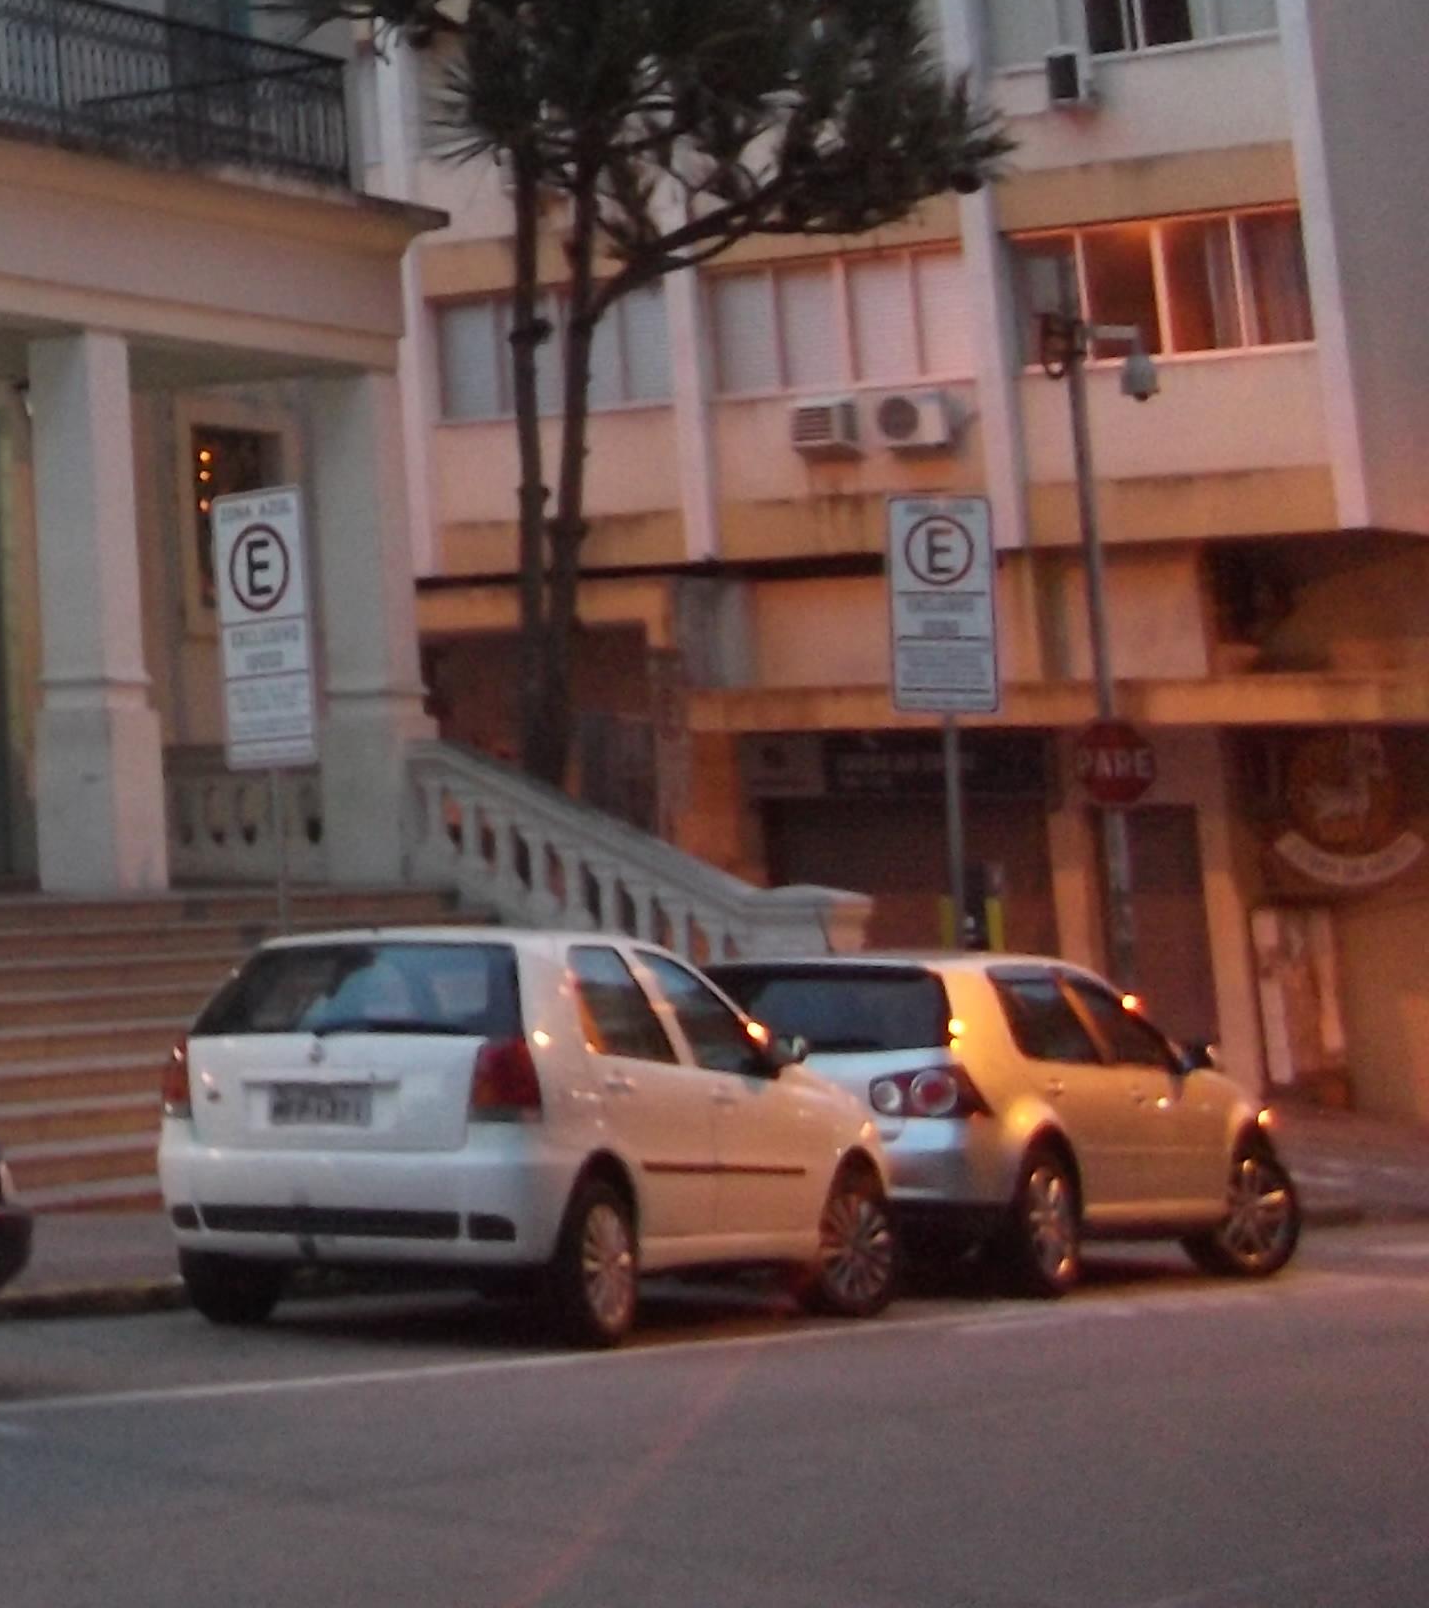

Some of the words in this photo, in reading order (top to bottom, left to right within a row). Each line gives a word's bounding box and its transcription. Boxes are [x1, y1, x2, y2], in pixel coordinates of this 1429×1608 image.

[246, 540, 274, 597] E
[926, 527, 955, 575] E
[1076, 748, 1152, 779] PARE
